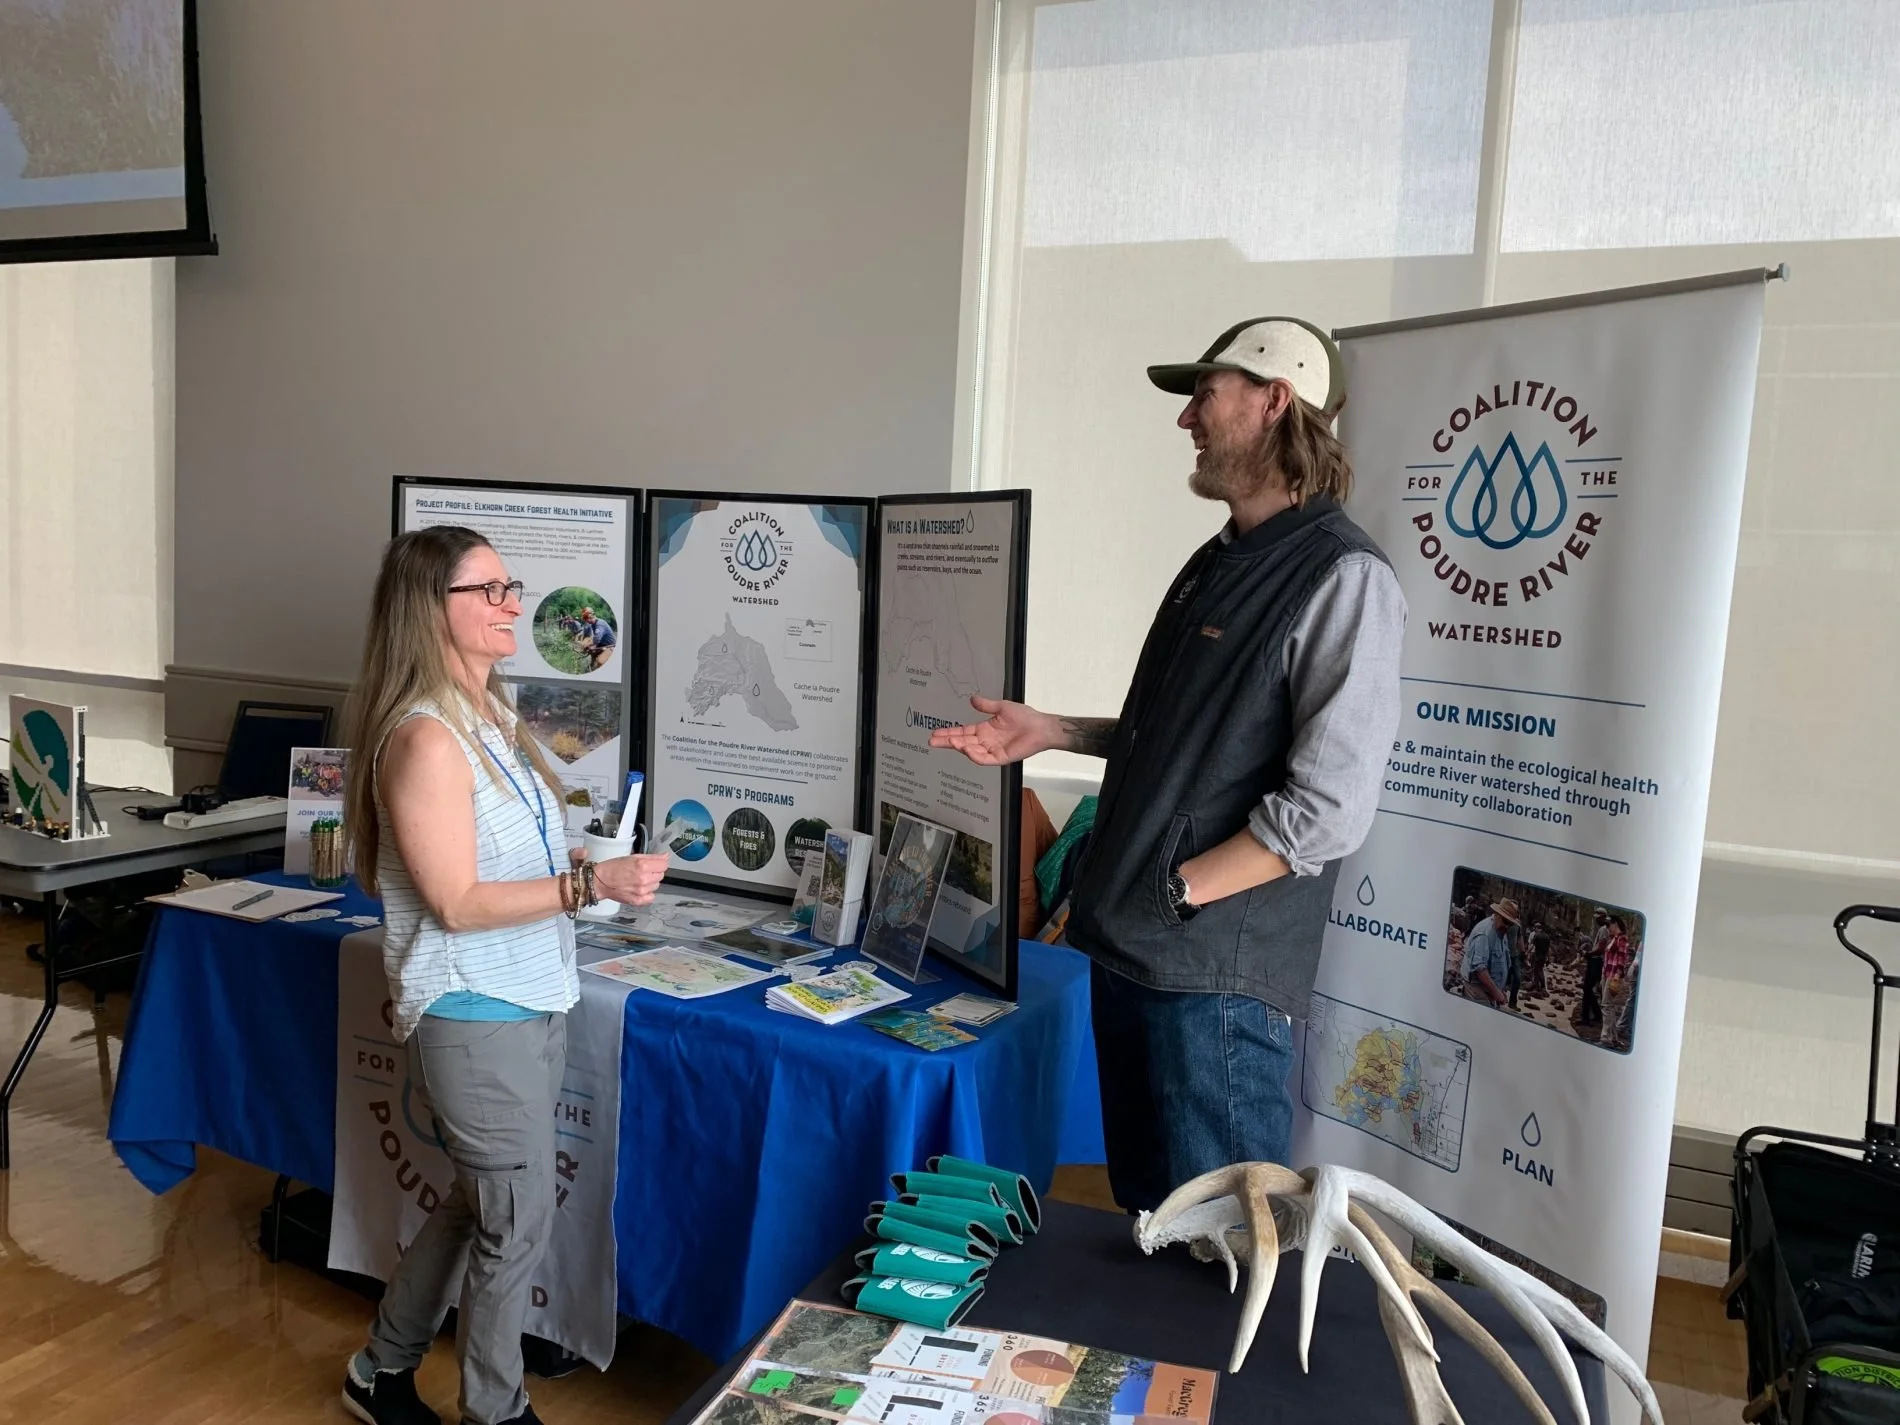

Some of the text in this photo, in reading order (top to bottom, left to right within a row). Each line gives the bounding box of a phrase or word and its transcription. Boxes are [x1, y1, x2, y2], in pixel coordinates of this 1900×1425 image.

[1432, 380, 1598, 453] COALITION
[1408, 471, 1618, 489] FOR THE
[416, 499, 443, 508] PROJECT
[474, 502, 502, 511] ELKHORN
[504, 503, 525, 512] CREEK
[527, 505, 551, 514] FOREST
[553, 506, 578, 516] HEALTH
[579, 508, 613, 518] INITIATIVE
[728, 512, 785, 537] COALITION
[913, 521, 918, 534] A
[1412, 511, 1602, 607] POUDRE RIVER
[724, 556, 789, 591] POUDRE RIVER
[732, 596, 779, 606] WATERSHED
[1428, 621, 1562, 649] WATERSHED
[793, 682, 811, 691] Cache
[819, 685, 840, 693] Poudre
[802, 694, 833, 703] Watershed
[913, 711, 953, 730] WATERSHED
[1416, 701, 1556, 738] OUR MISSION
[672, 735, 698, 744] Coalition
[718, 741, 739, 749] Poudre
[741, 743, 756, 751] River
[757, 746, 790, 755] Watershed
[790, 750, 812, 759] (CPRW)
[813, 753, 849, 762] collaborates
[679, 746, 712, 755] stakeholders
[762, 756, 786, 765] available
[787, 759, 808, 767] science
[816, 762, 842, 771] prioritize
[712, 760, 741, 768] watershed
[1405, 740, 1416, 754] &
[1420, 742, 1486, 766] maintain
[1490, 752, 1514, 770] the
[1518, 759, 1597, 785] ecological
[1600, 771, 1659, 796] health
[744, 788, 795, 807] PROGRAMS
[1440, 765, 1478, 785] River
[1481, 776, 1561, 802] watershed
[1565, 790, 1631, 817] through
[1384, 779, 1573, 827] community collaboration
[739, 838, 758, 851] FIRES
[760, 832, 765, 840] &
[794, 836, 825, 849] WATERSH
[1327, 908, 1428, 950] LLABORATE
[358, 1050, 395, 1074] FOR
[368, 1100, 441, 1214] POUD
[1502, 1148, 1554, 1187] PLAN
[1003, 1334, 1018, 1351] 360
[977, 1348, 994, 1368] FUNDING
[975, 1394, 989, 1413] 365
